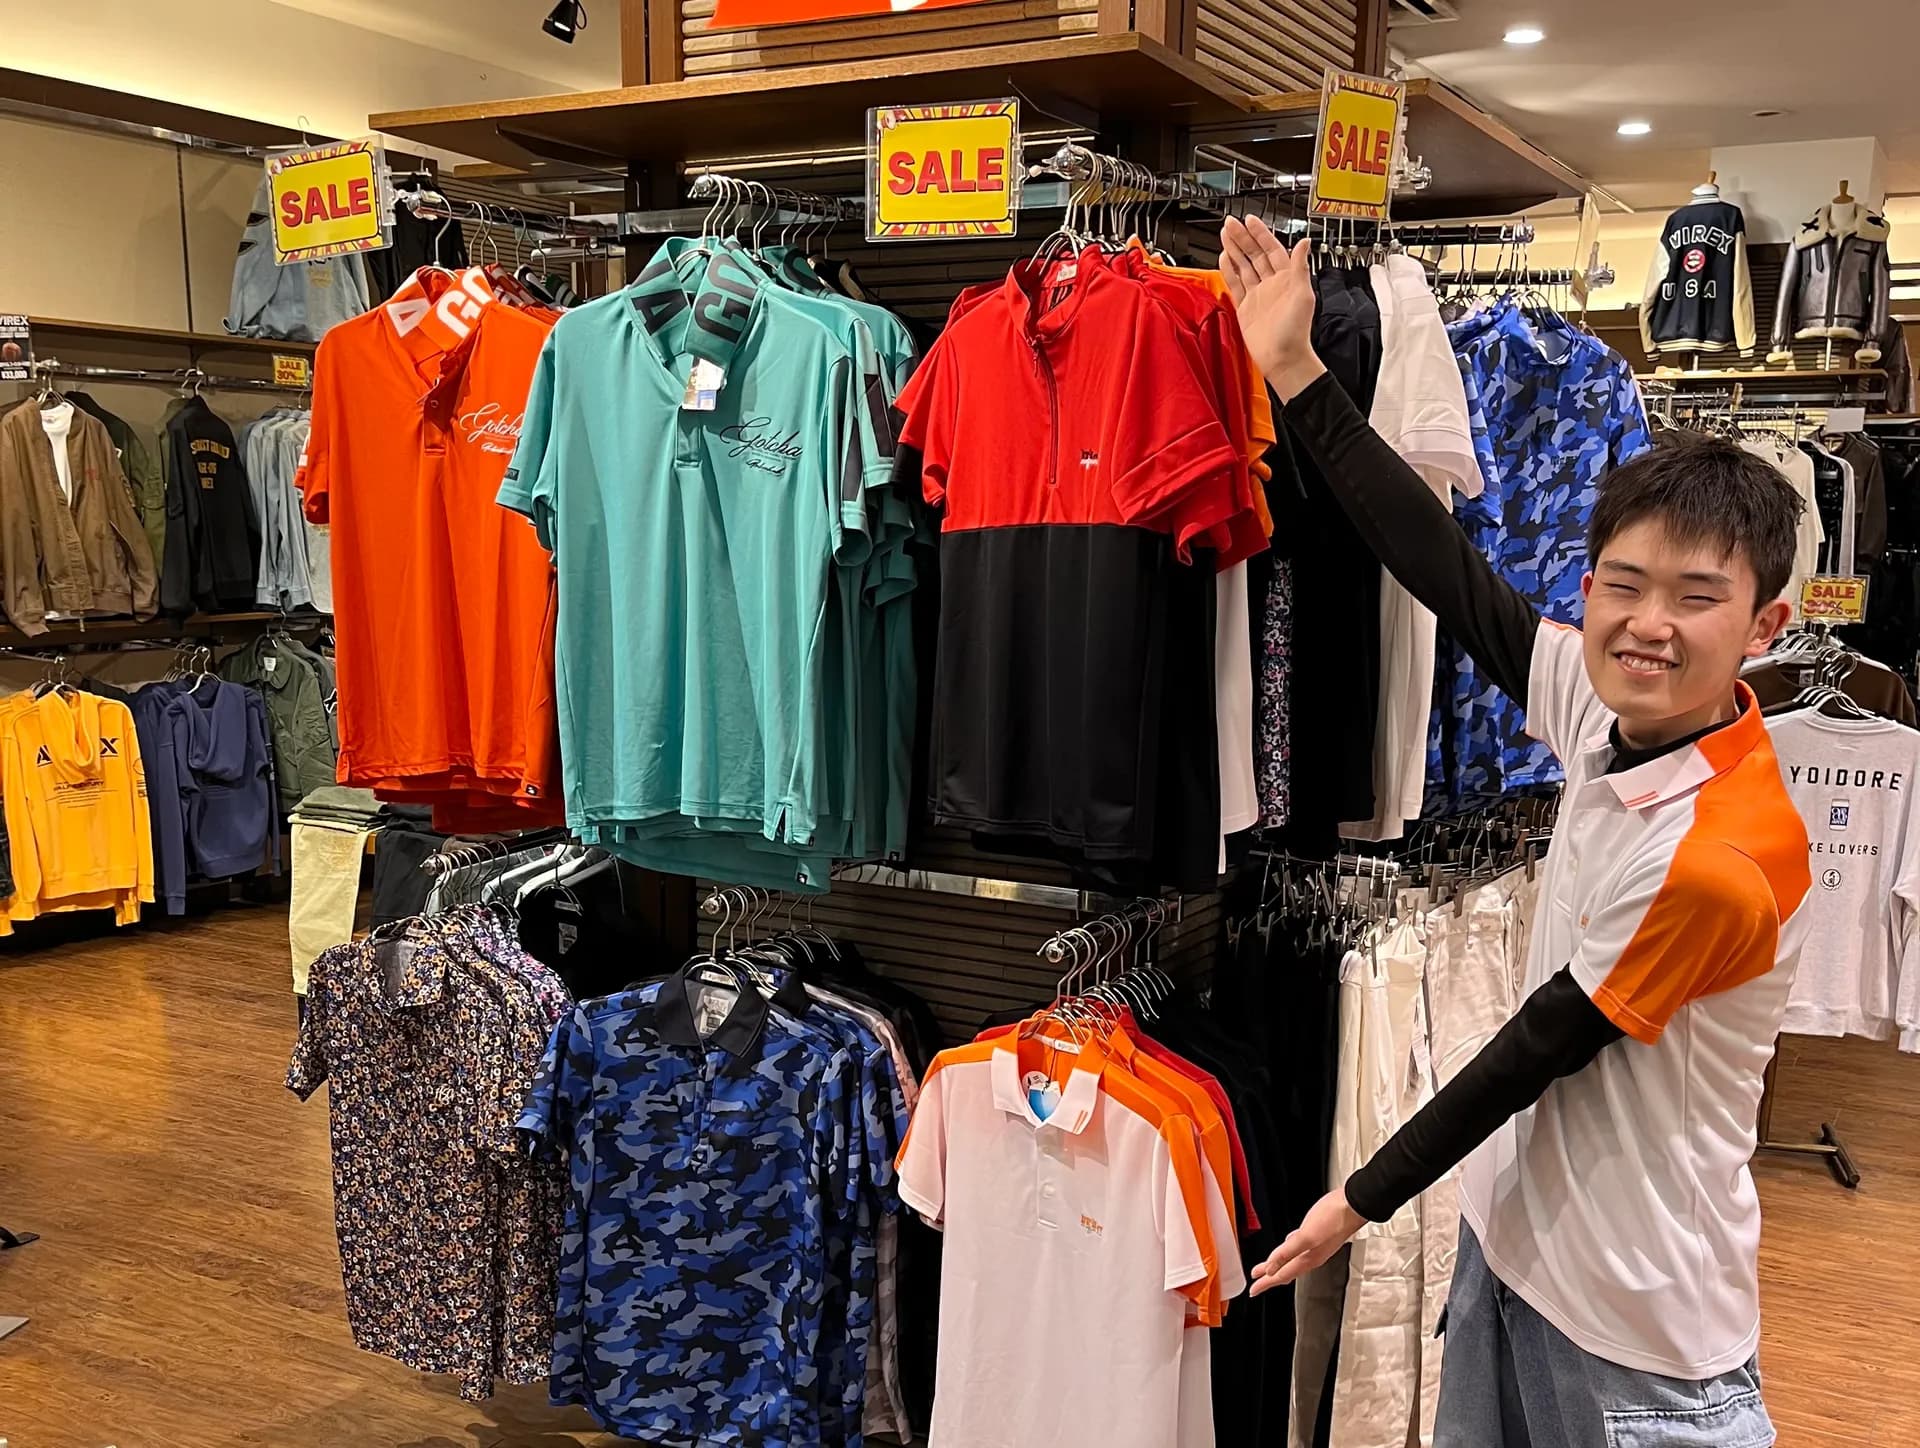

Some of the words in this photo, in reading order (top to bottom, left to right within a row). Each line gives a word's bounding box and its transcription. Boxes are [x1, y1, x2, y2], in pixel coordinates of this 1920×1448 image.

[1326, 120, 1390, 176] SALE
[888, 147, 1004, 195] SALE
[280, 177, 371, 227] SALE
[279, 360, 302, 370] SALE
[720, 416, 803, 458] Gotcha
[1811, 584, 1857, 599] SALE
[1789, 765, 1903, 791] YOIDORE
[1829, 842, 1878, 856] LOVERS
